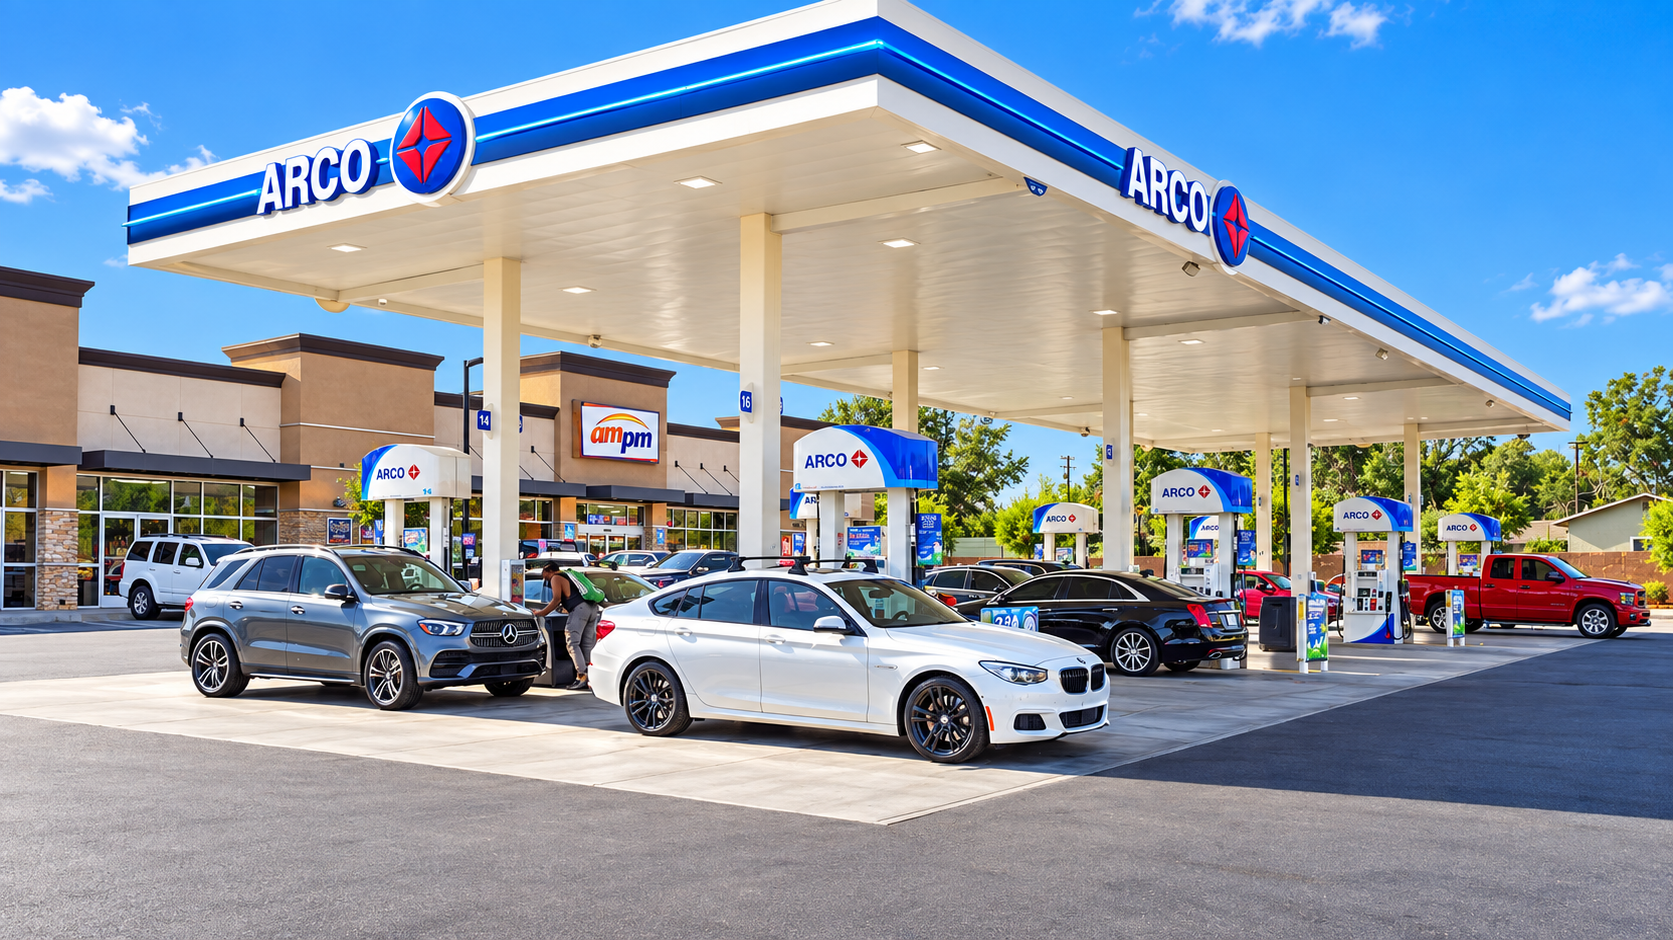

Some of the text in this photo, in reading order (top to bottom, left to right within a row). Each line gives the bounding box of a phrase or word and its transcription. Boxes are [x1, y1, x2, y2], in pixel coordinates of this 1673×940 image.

[257, 138, 375, 215] ARCO
[1126, 147, 1209, 233] ARCO
[742, 395, 751, 408] 16
[479, 414, 489, 426] 14
[590, 426, 652, 454] ampm
[804, 453, 847, 469] ARCO
[376, 467, 405, 480] ARCO
[1161, 487, 1195, 498] ARCO
[804, 496, 817, 505] AR
[1343, 511, 1369, 519] ARCO
